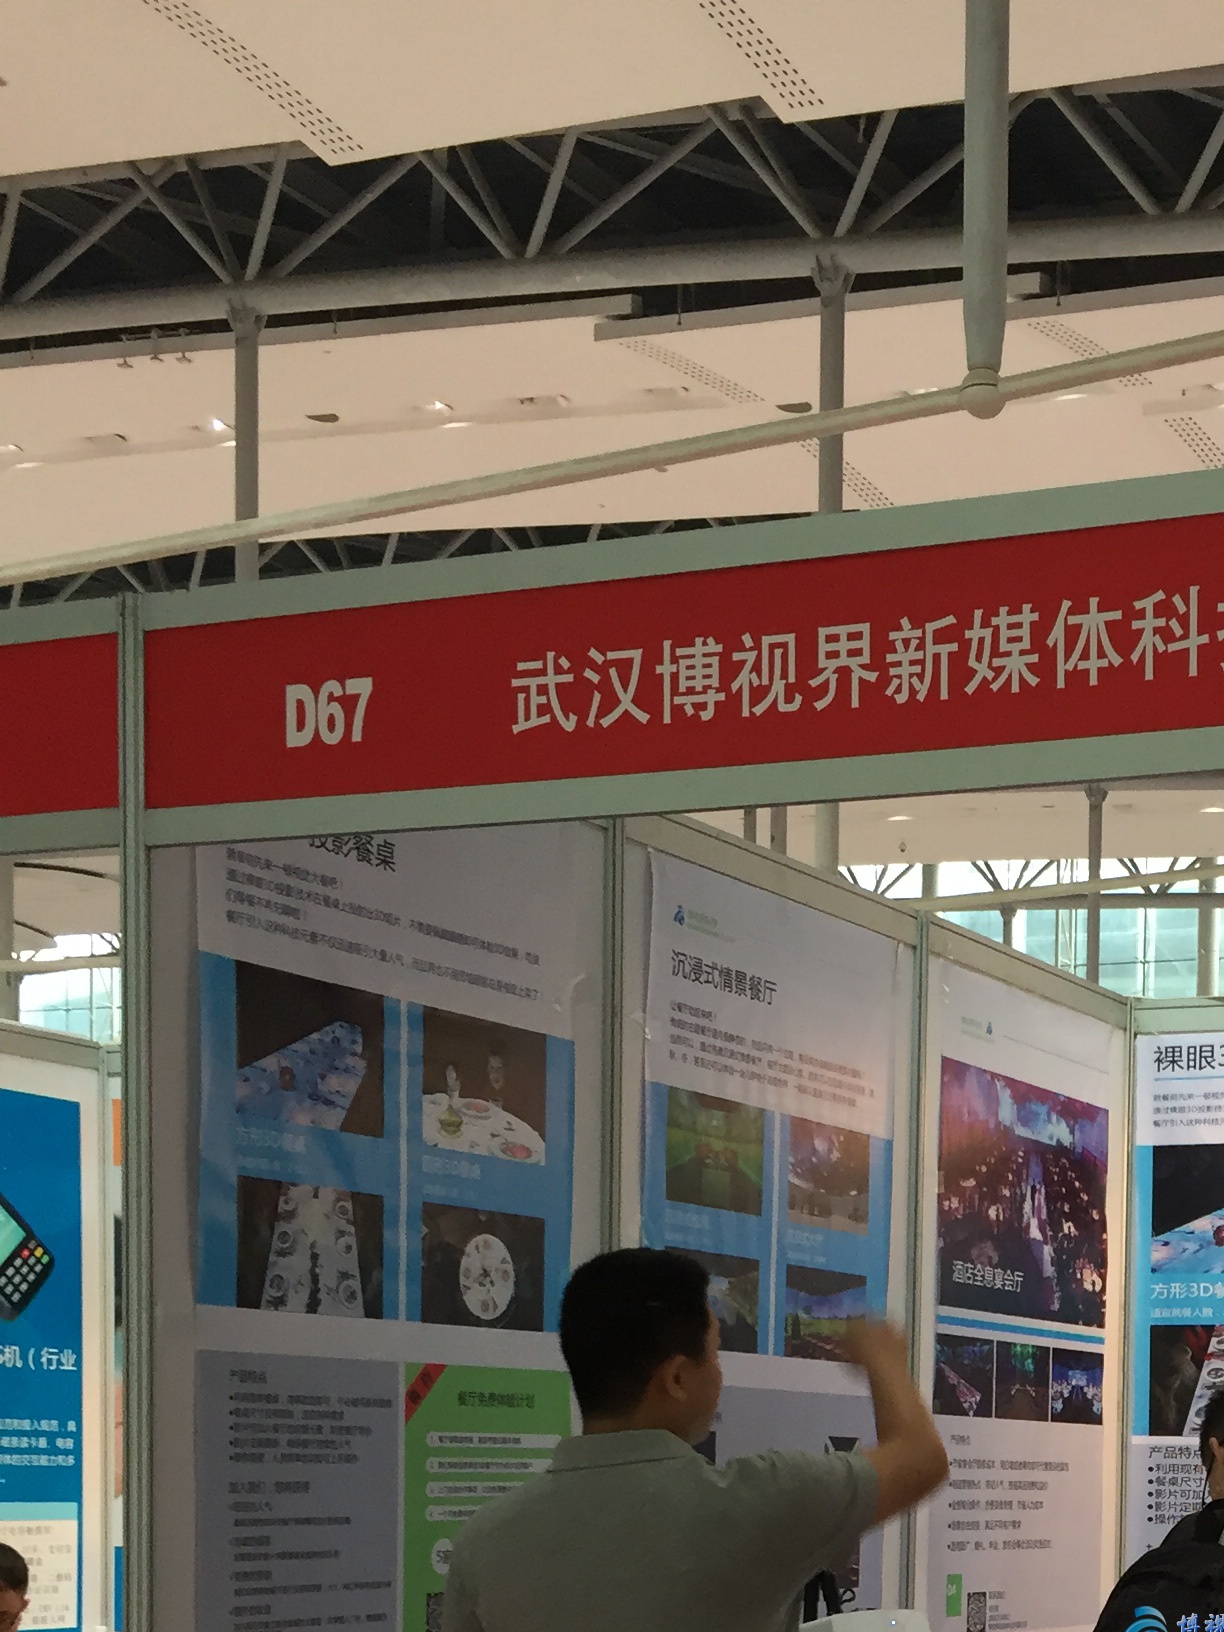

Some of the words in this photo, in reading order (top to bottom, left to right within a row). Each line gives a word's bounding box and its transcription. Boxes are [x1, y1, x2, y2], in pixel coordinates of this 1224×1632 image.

[286, 677, 373, 749] D67
[671, 949, 777, 1005] 沉浸式情景餐厅
[1154, 1476, 1205, 1488] 餐桌尺寸
[1154, 1489, 1209, 1500] 影片可加
